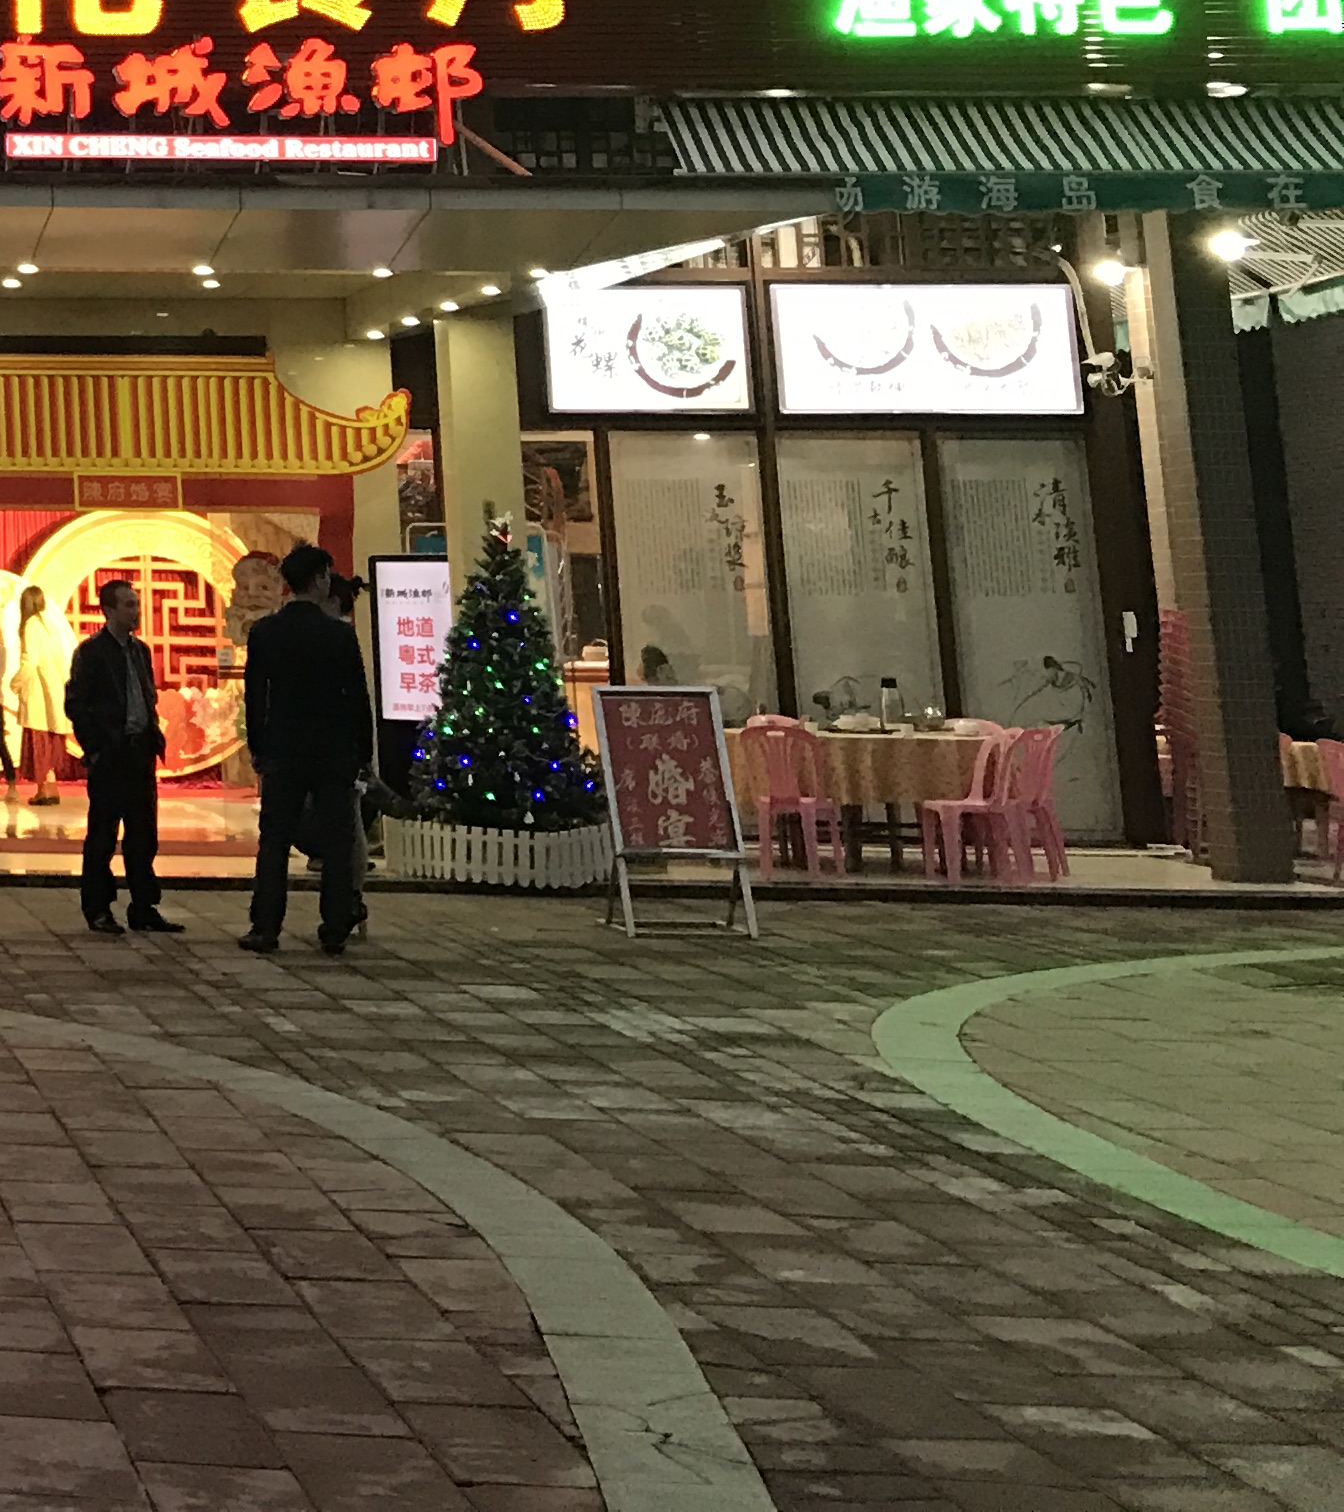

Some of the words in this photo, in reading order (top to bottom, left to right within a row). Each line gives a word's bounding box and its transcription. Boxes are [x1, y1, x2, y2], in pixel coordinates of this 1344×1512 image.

[13, 136, 63, 156] XIN
[68, 137, 168, 157] CHENG
[174, 138, 279, 158] Seafood
[284, 139, 430, 159] Restaurant
[396, 616, 435, 638] 地道
[399, 671, 437, 694] 早茶
